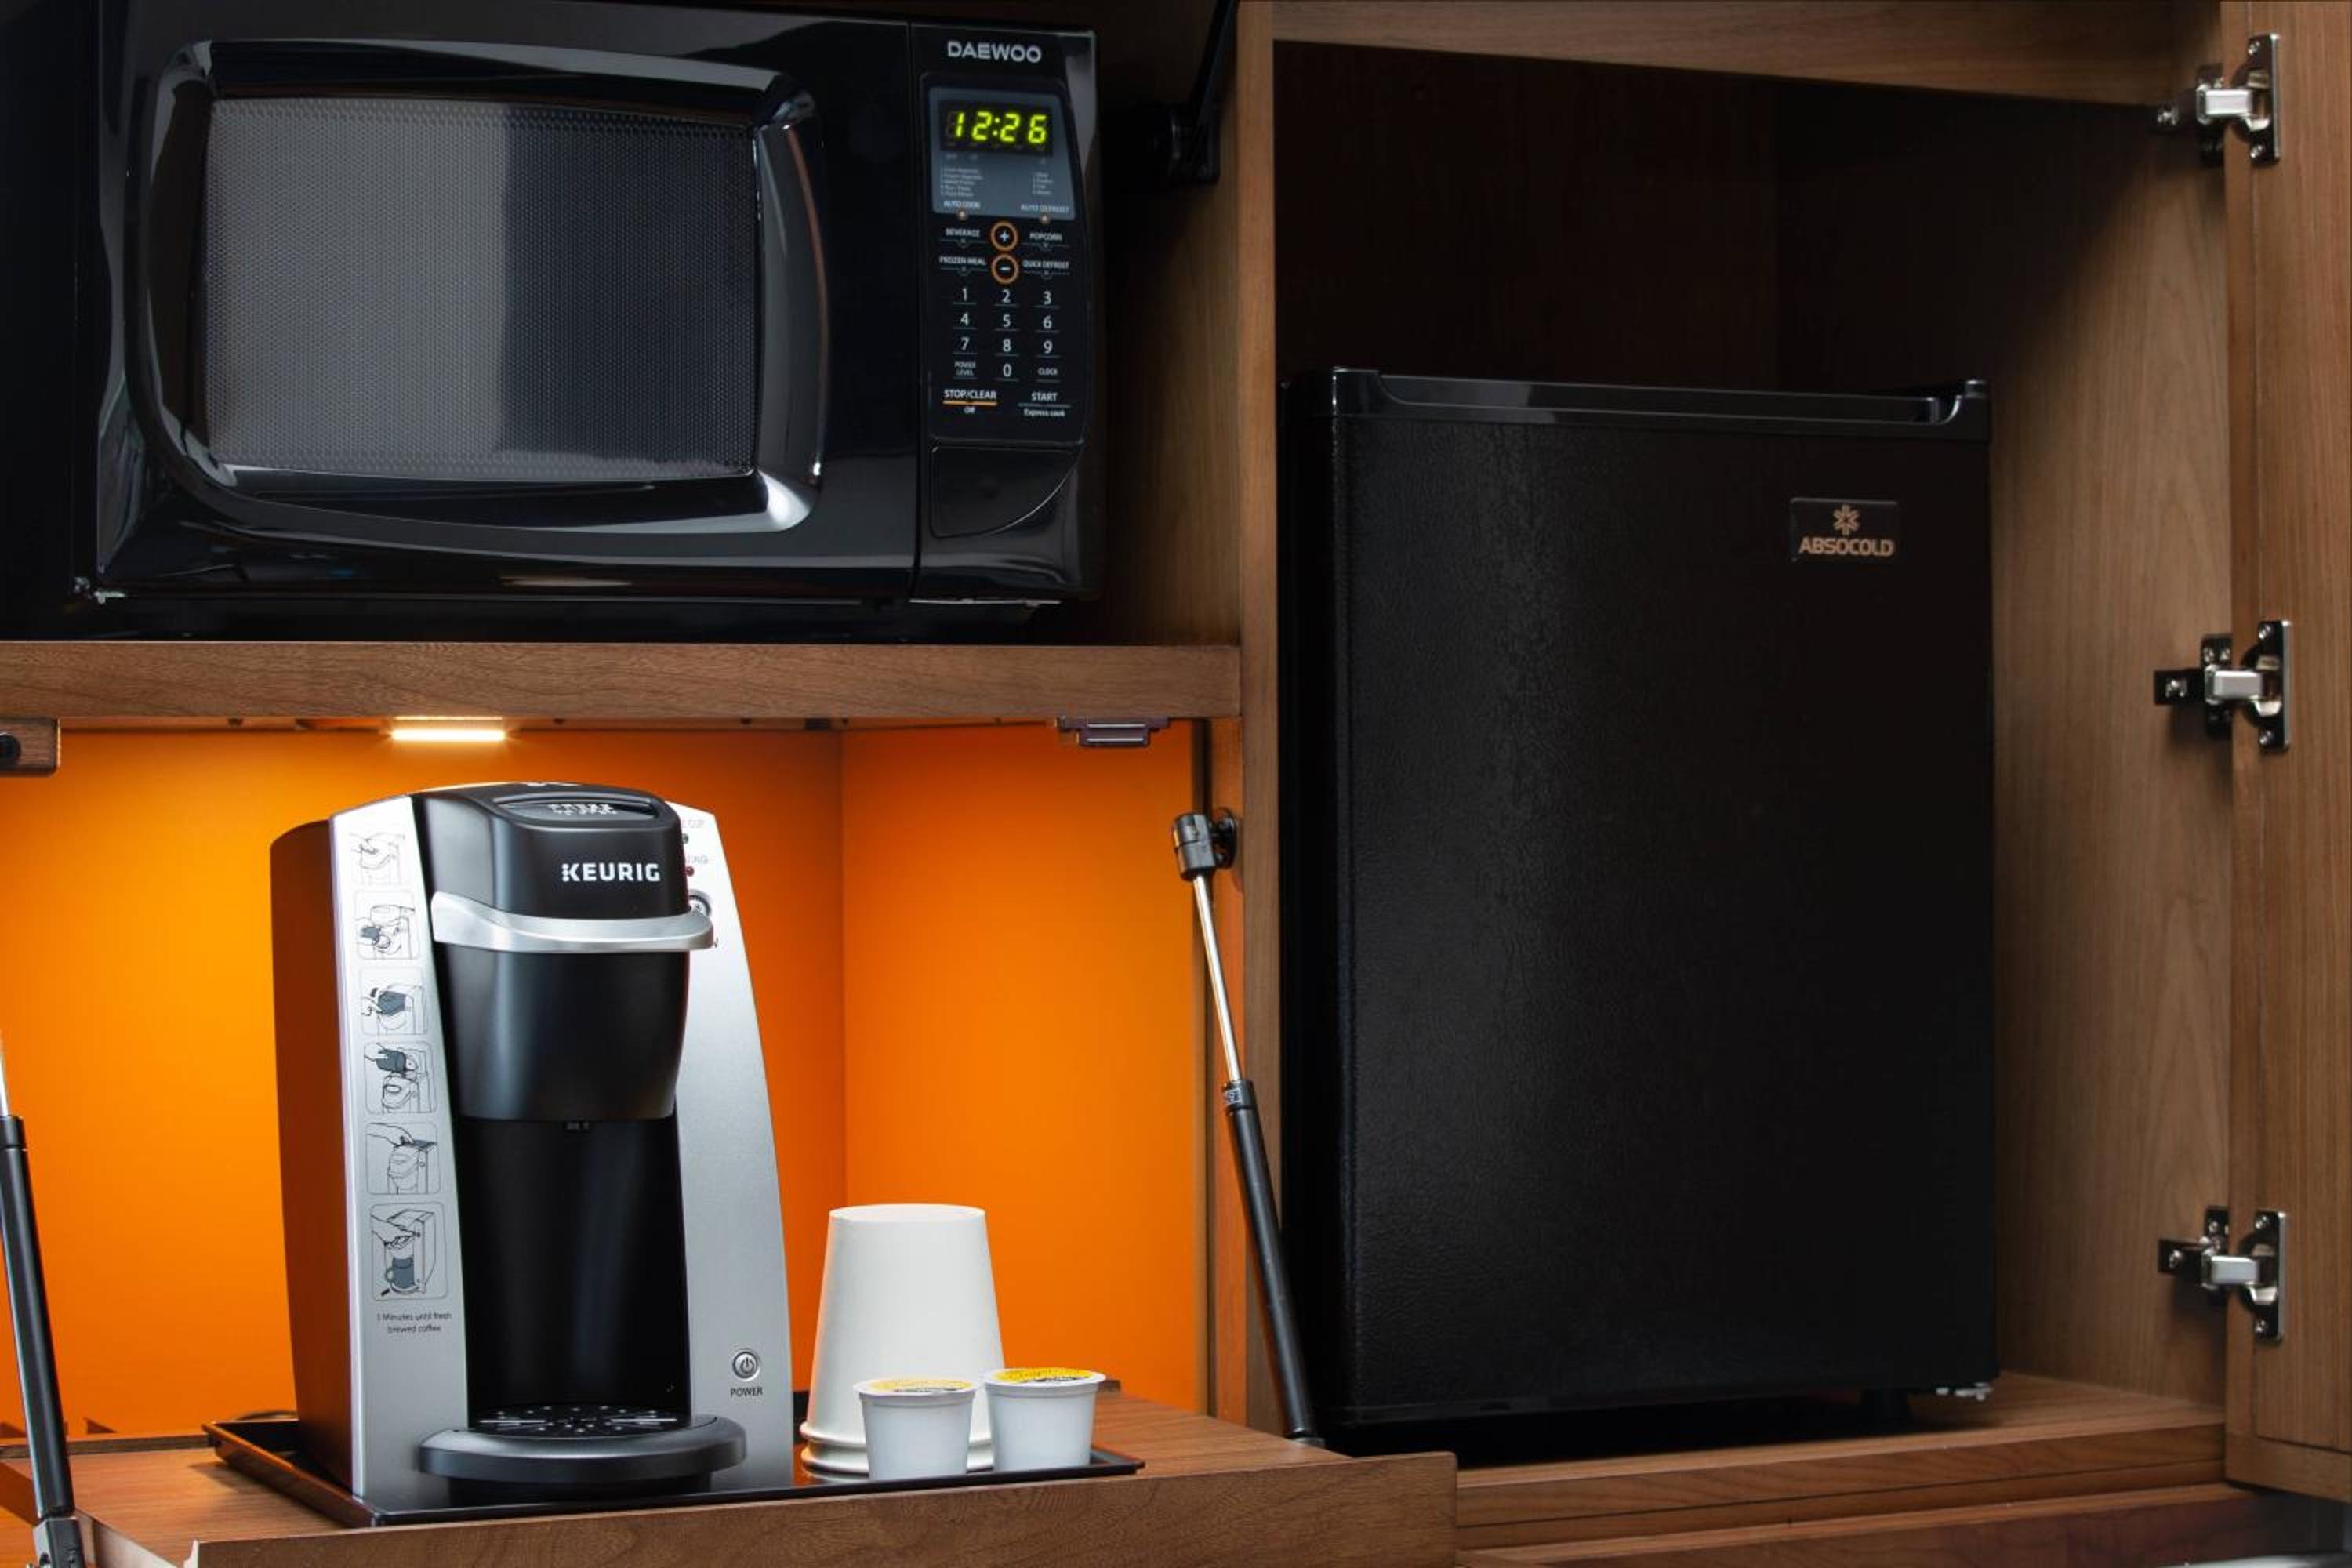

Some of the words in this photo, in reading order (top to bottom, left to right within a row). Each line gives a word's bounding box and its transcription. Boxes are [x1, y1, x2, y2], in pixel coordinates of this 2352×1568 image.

[947, 41, 1042, 63] DAEWOO
[955, 111, 1047, 143] 12:26
[945, 228, 980, 237] BEVERAGE
[1029, 232, 1062, 241] POPCORN
[961, 288, 967, 301] 1
[1002, 289, 1011, 303] 2
[1043, 291, 1051, 304] 3
[960, 313, 969, 325] 4
[1003, 314, 1011, 327] 5
[1043, 315, 1052, 329] 6
[961, 337, 969, 350] 7
[1003, 339, 1011, 352] 8
[1044, 340, 1052, 354] 9
[1003, 364, 1011, 377] 0
[944, 389, 996, 399] STOP/CLEAR
[1031, 392, 1058, 401] START
[1798, 536, 1895, 557] ABSOCOLD
[561, 862, 661, 882] KEURIG
[730, 1386, 763, 1398] POWER
